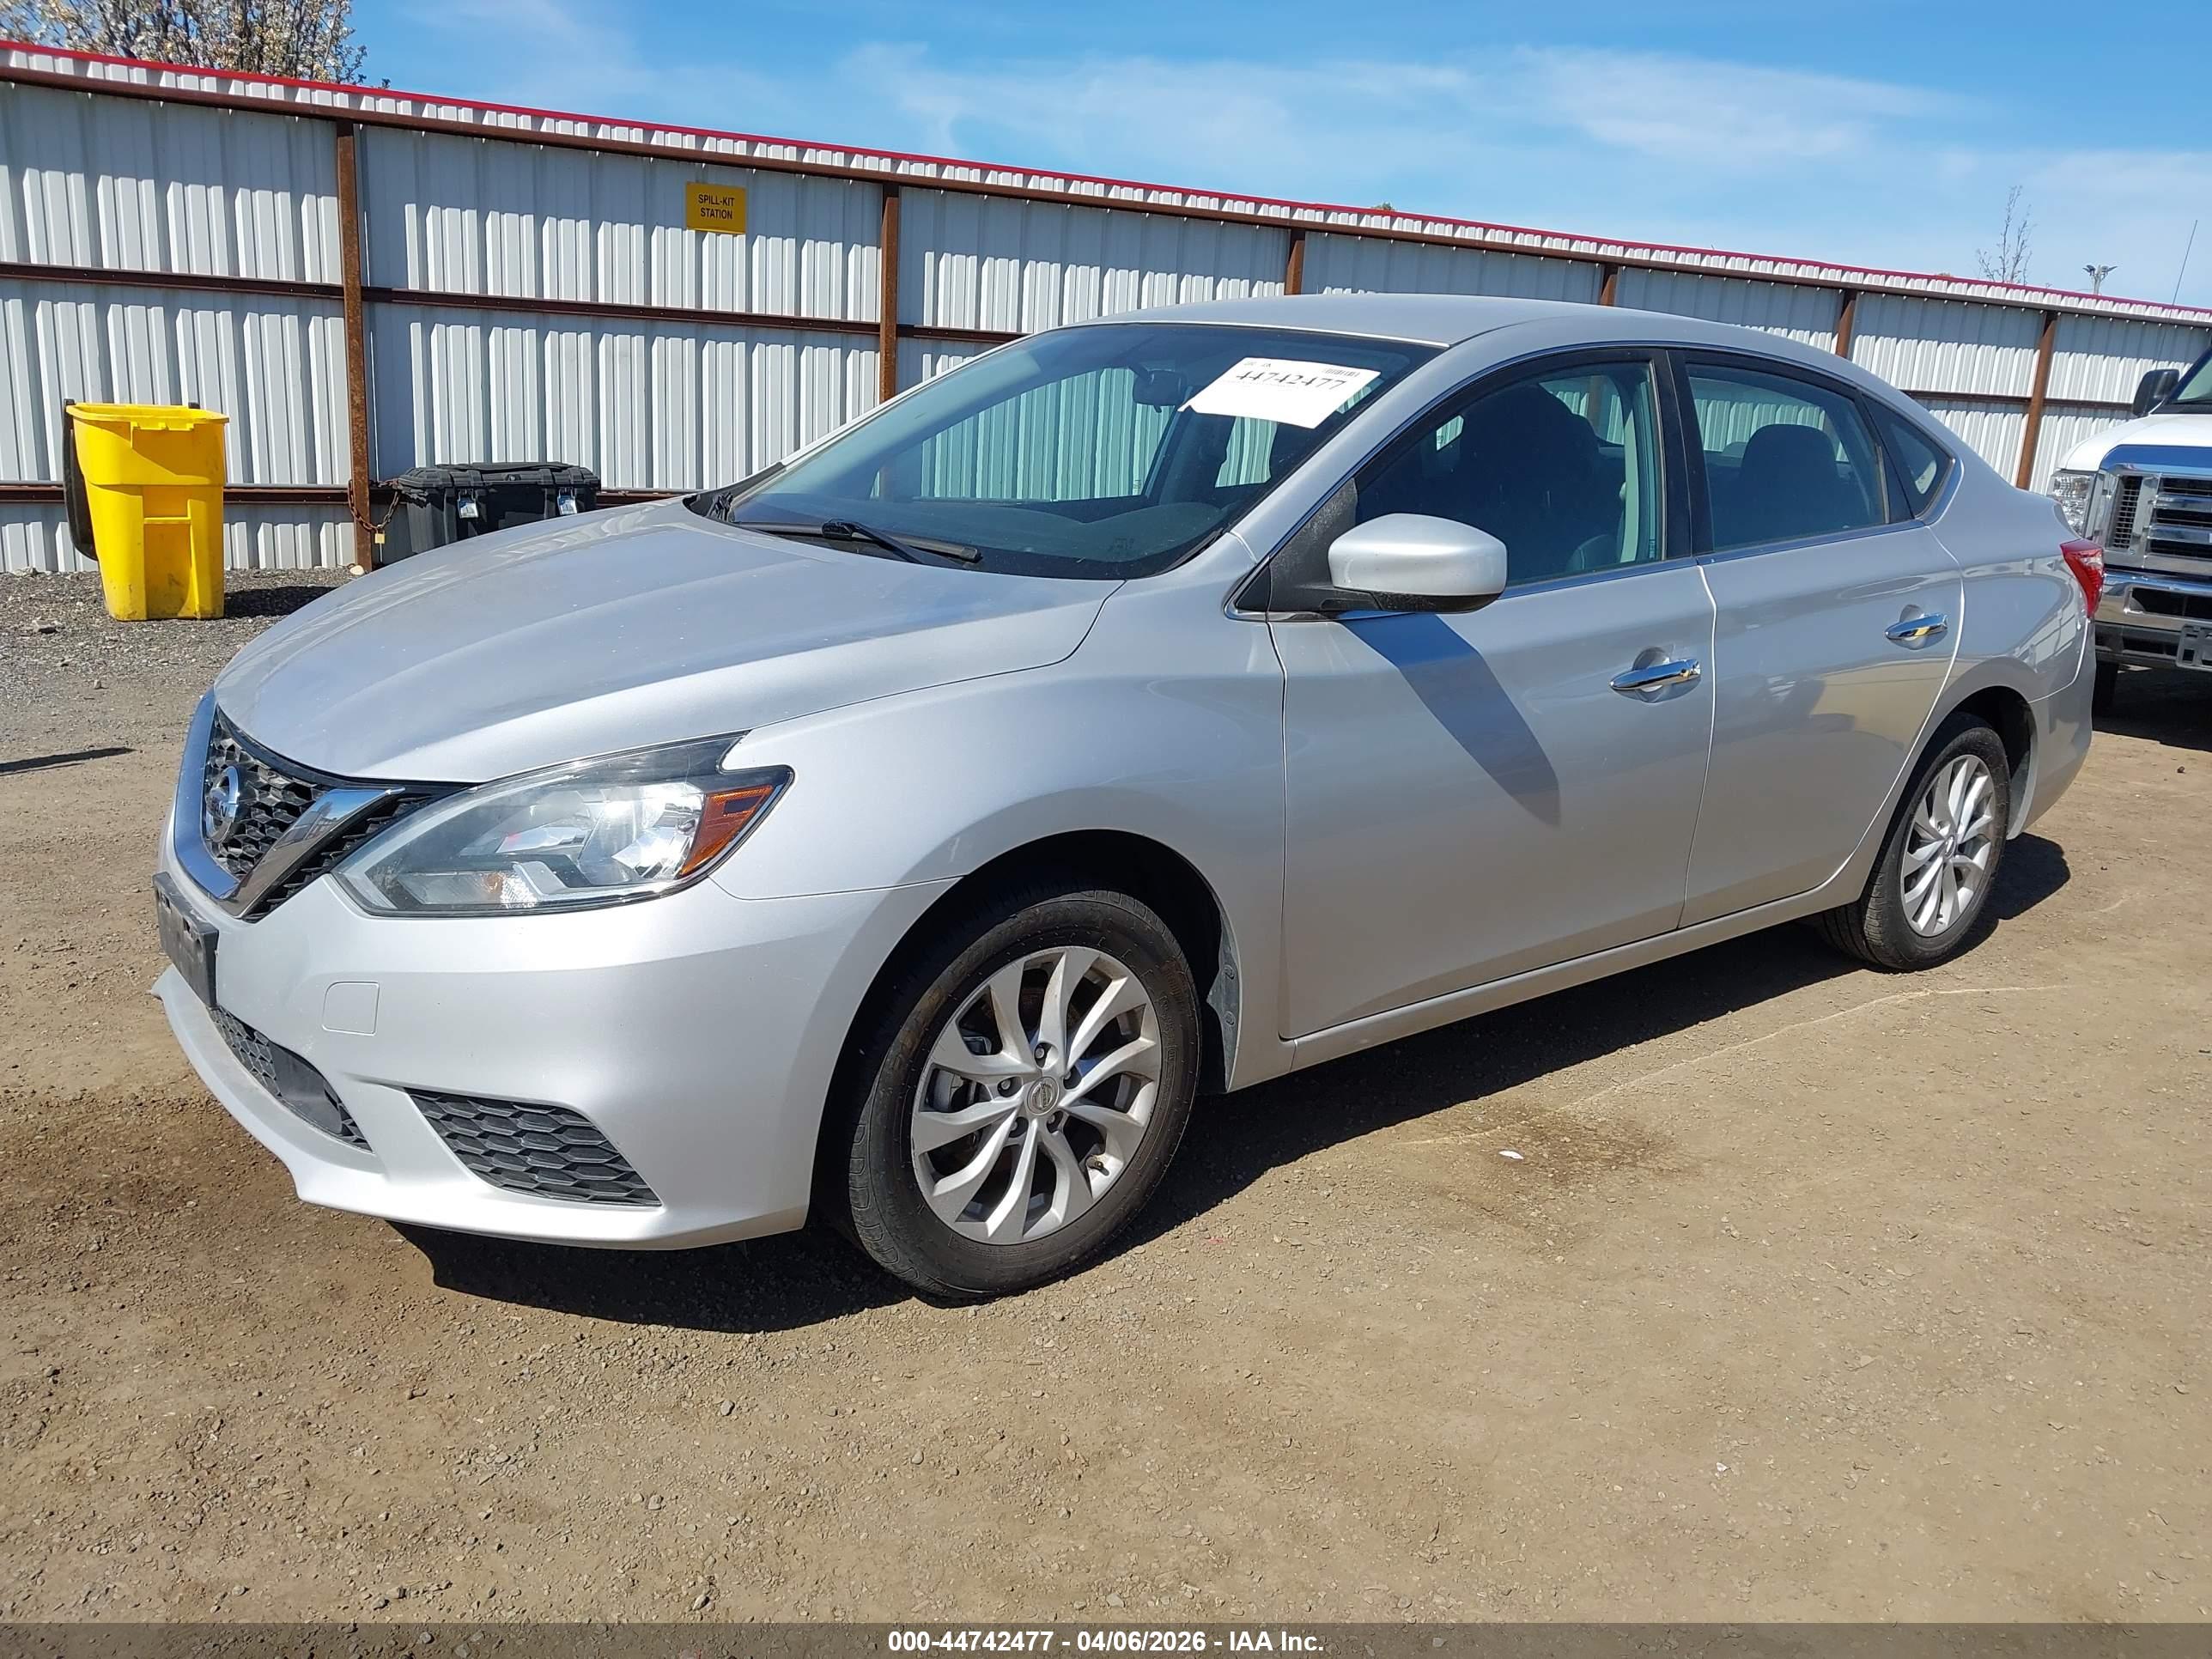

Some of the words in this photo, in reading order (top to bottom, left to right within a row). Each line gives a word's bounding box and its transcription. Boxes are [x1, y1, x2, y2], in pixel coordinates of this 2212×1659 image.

[698, 194, 735, 206] SPILL-KIT
[700, 207, 732, 220] STATION
[1237, 370, 1346, 389] 44742477
